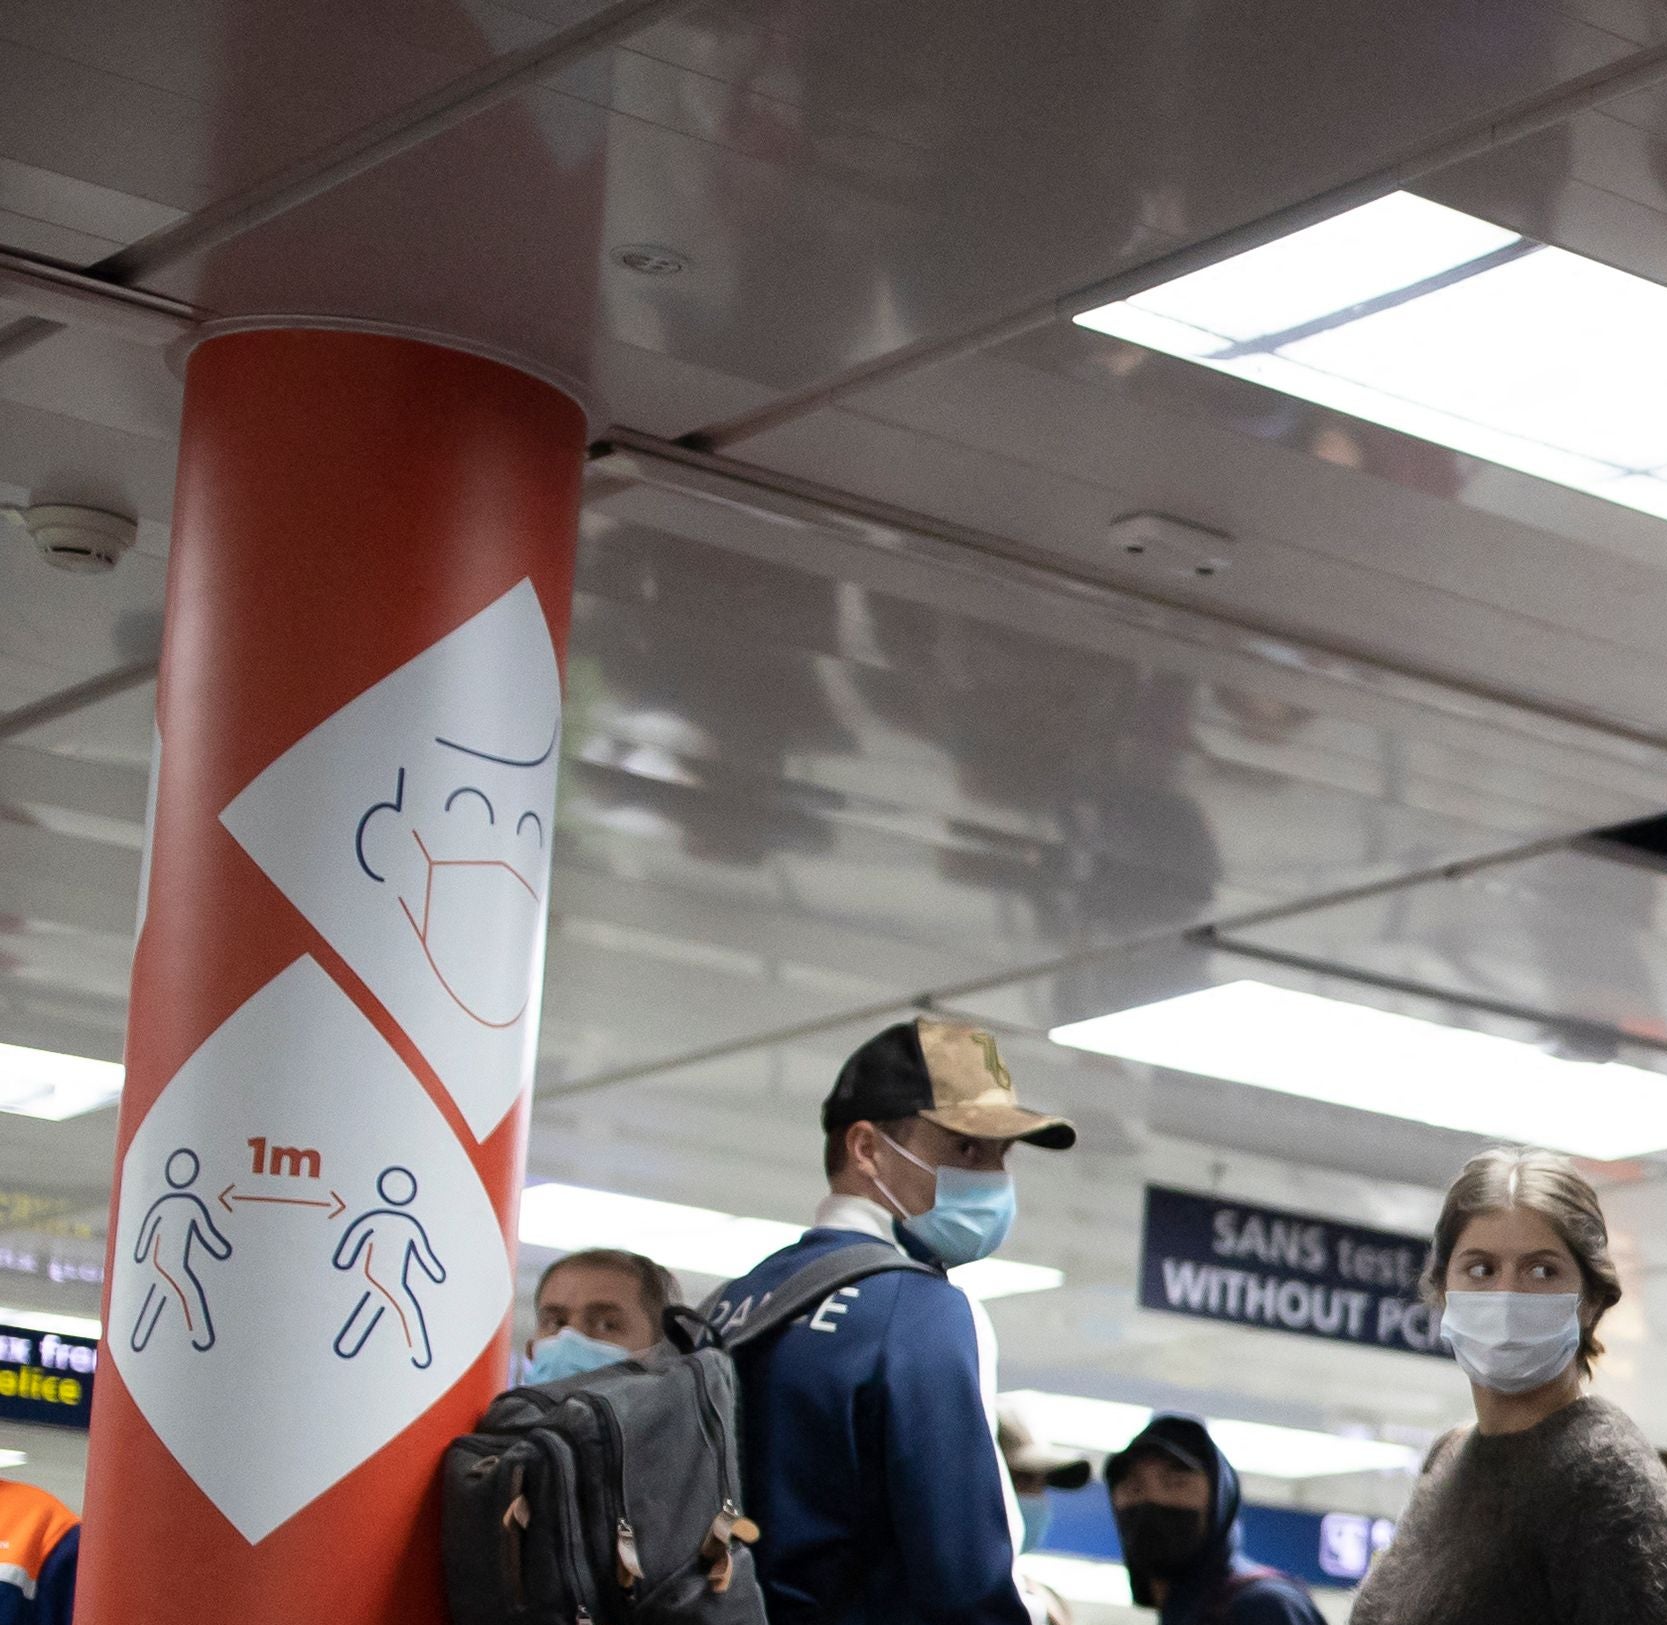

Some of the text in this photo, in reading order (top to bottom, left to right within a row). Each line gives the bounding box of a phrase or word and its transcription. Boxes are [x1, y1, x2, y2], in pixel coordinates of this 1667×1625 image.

[247, 1136, 322, 1178] 1m
[1211, 1208, 1326, 1272] SANS
[1161, 1257, 1368, 1337] WITHOUT
